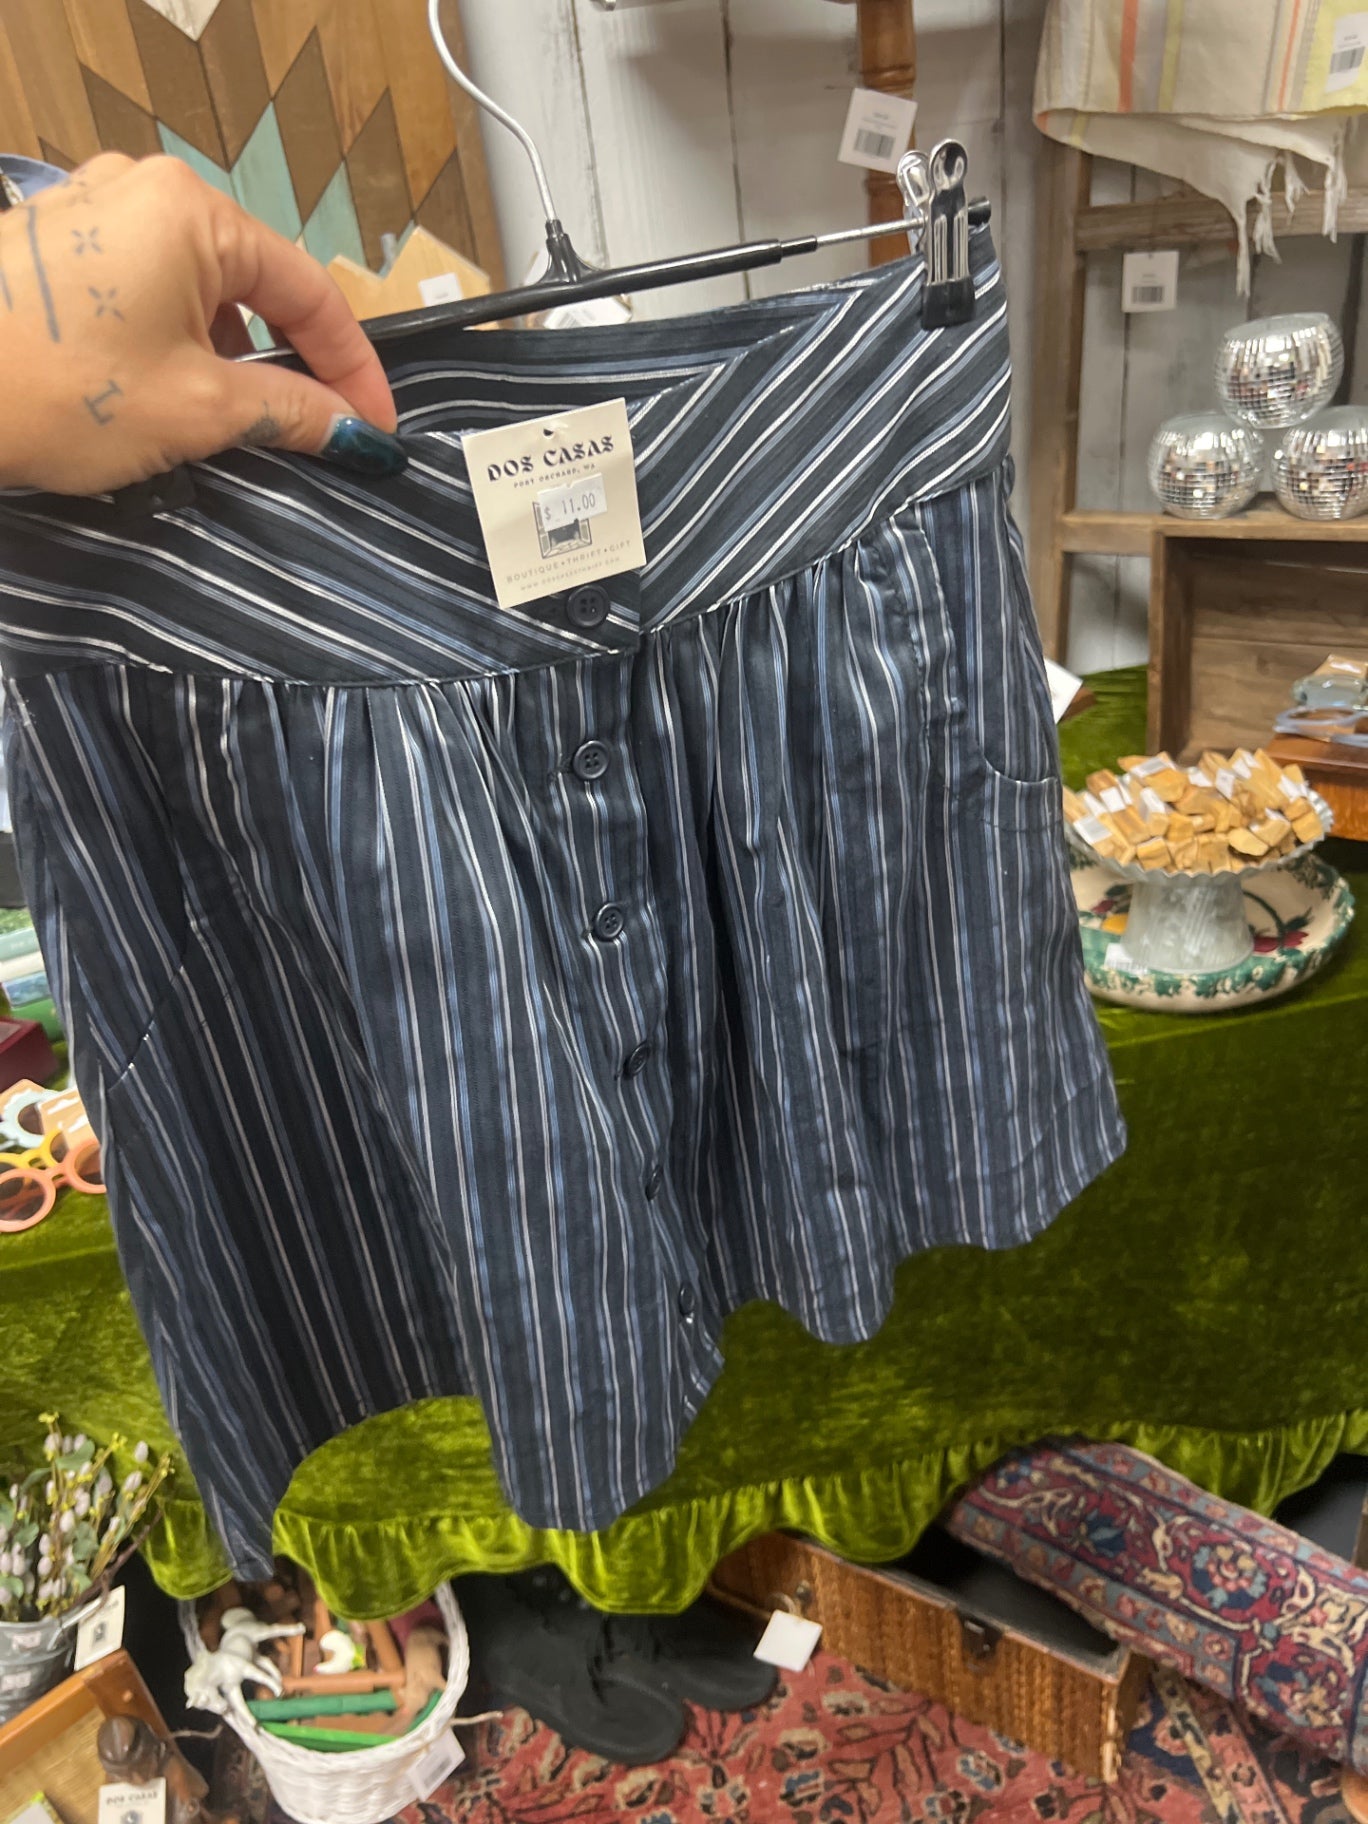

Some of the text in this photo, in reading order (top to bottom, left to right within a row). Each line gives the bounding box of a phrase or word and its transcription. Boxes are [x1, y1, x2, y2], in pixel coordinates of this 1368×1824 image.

[487, 435, 614, 482] DOS CASAS
[513, 479, 535, 489] PORT
[583, 463, 596, 471] WA
[561, 492, 596, 515] 11.00
